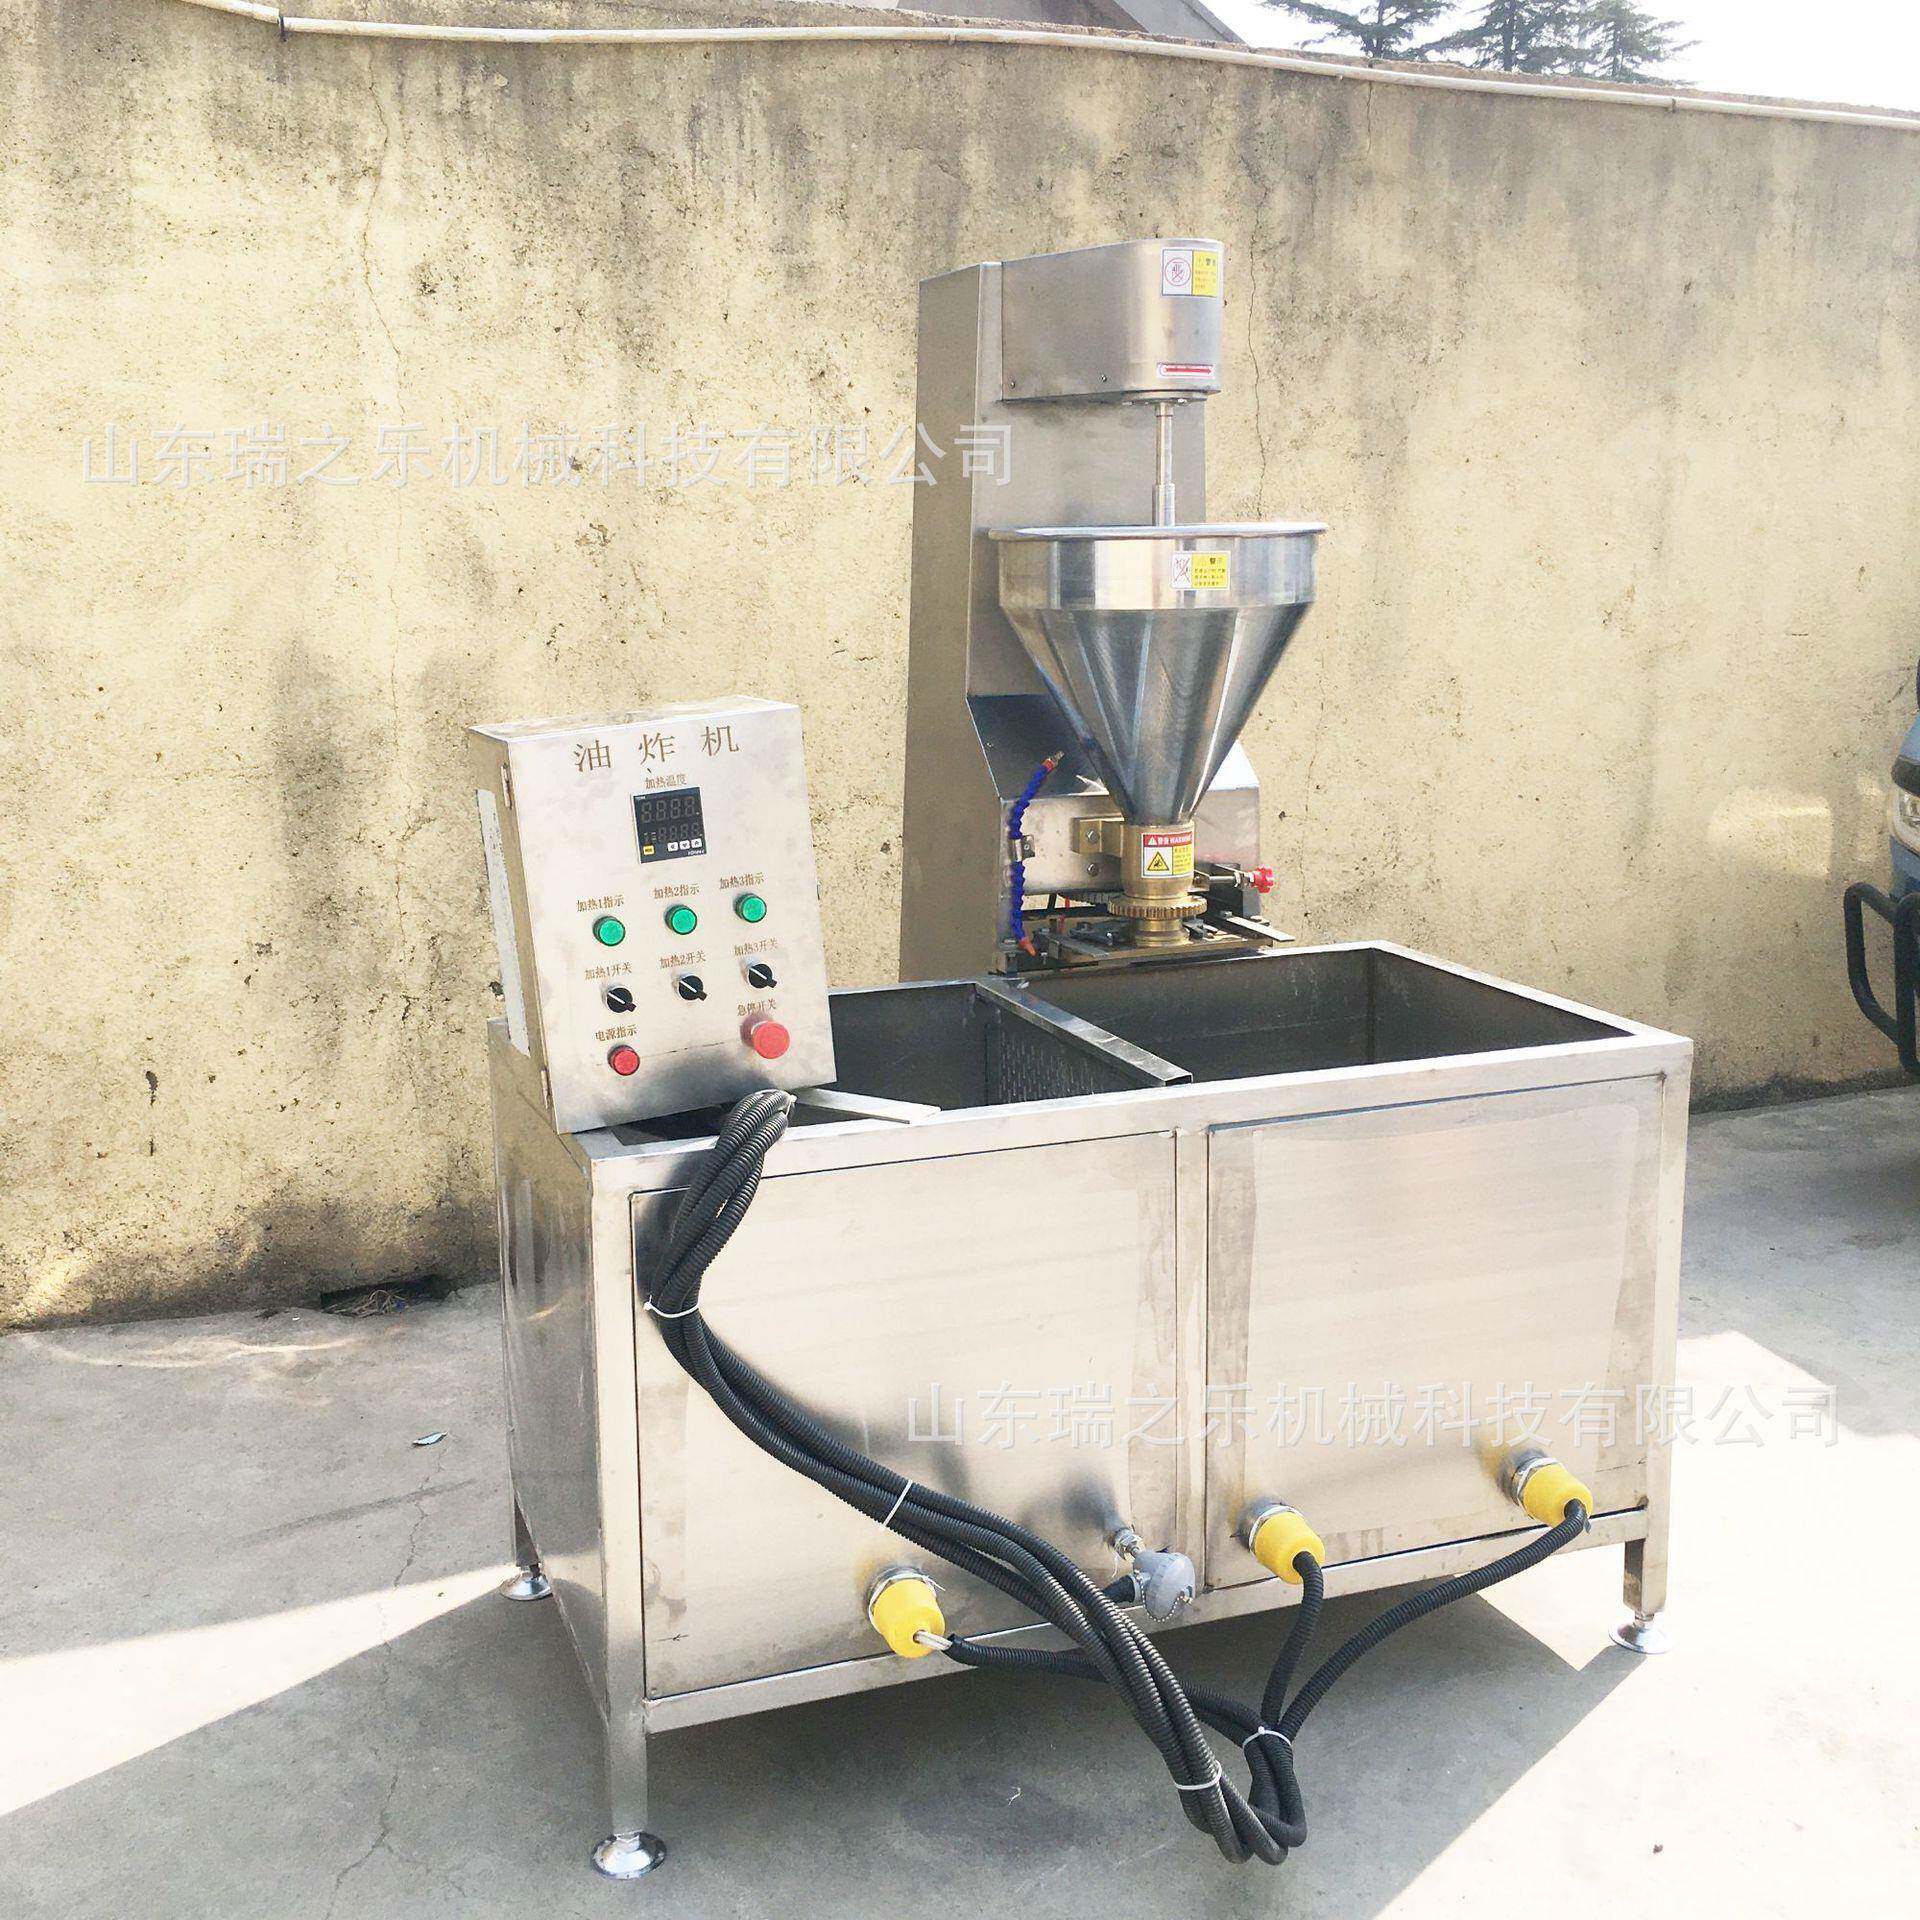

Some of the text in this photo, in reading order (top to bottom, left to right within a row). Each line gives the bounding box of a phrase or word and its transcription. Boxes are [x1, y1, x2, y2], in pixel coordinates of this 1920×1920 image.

[573, 725, 740, 772] 油炸机
[719, 872, 765, 890] 加热3指示
[653, 883, 700, 899] 加热2指示
[576, 894, 625, 912] 加热1指示
[659, 951, 706, 969] 加热2开关
[595, 1024, 637, 1041] 电源指示
